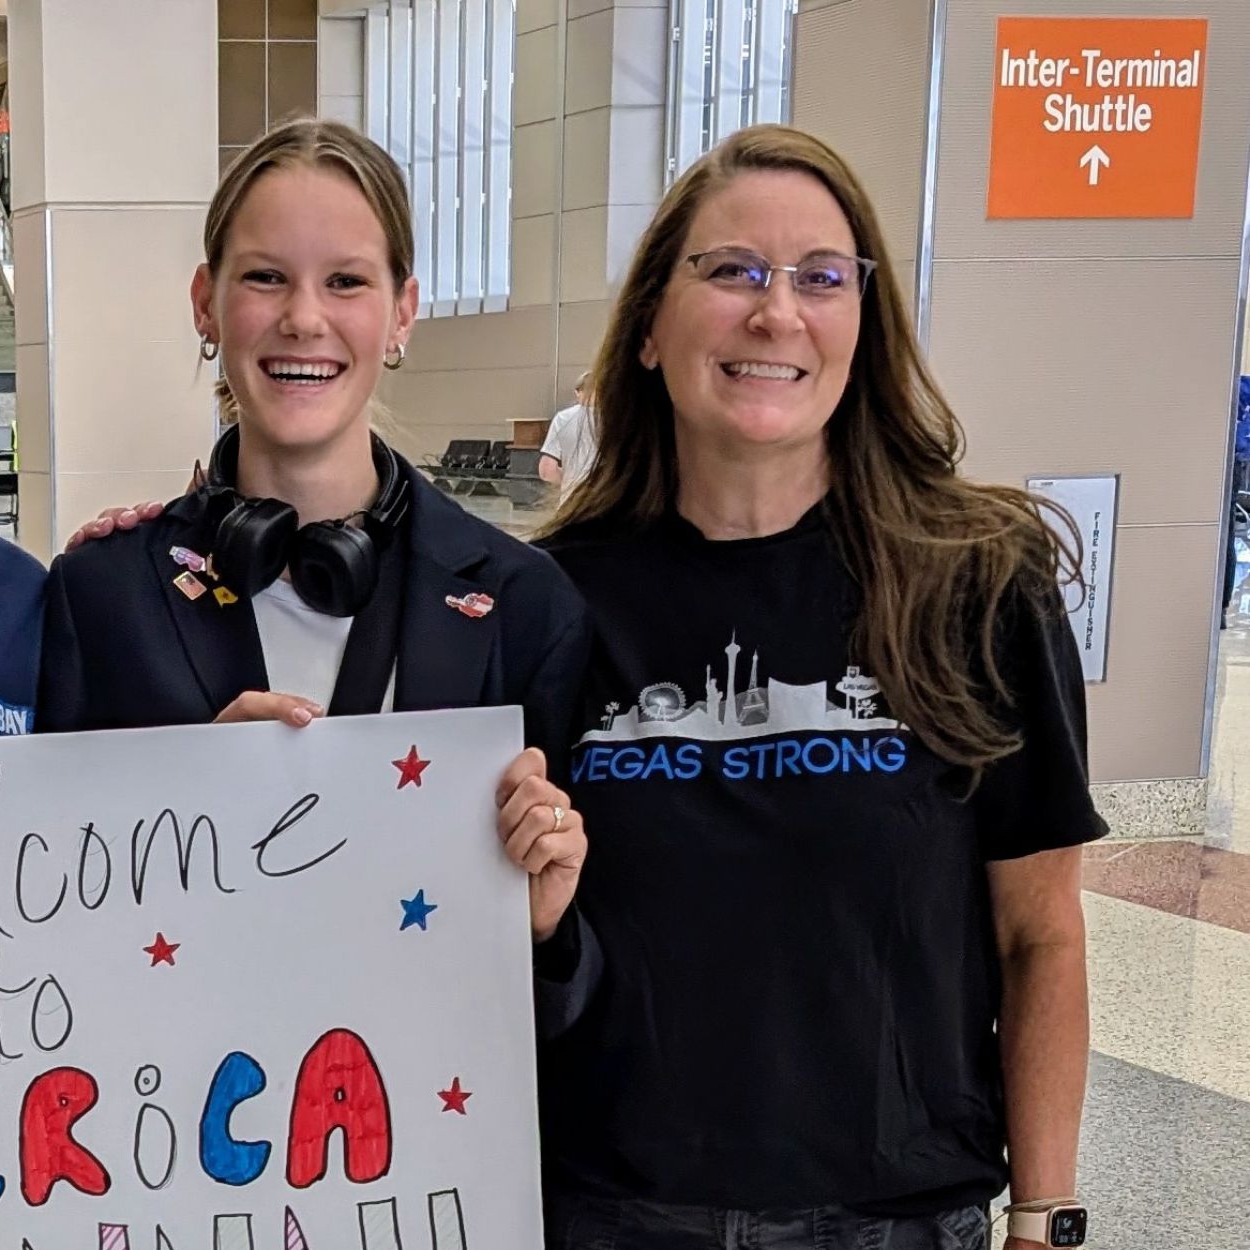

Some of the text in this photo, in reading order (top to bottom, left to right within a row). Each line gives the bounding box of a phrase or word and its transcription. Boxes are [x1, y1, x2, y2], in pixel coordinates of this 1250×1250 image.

[1001, 48, 1201, 87] Inter-Terminal
[1043, 93, 1152, 132] Shuttle
[1092, 511, 1101, 547] FIRE
[571, 737, 906, 783] VEGAS STRONG
